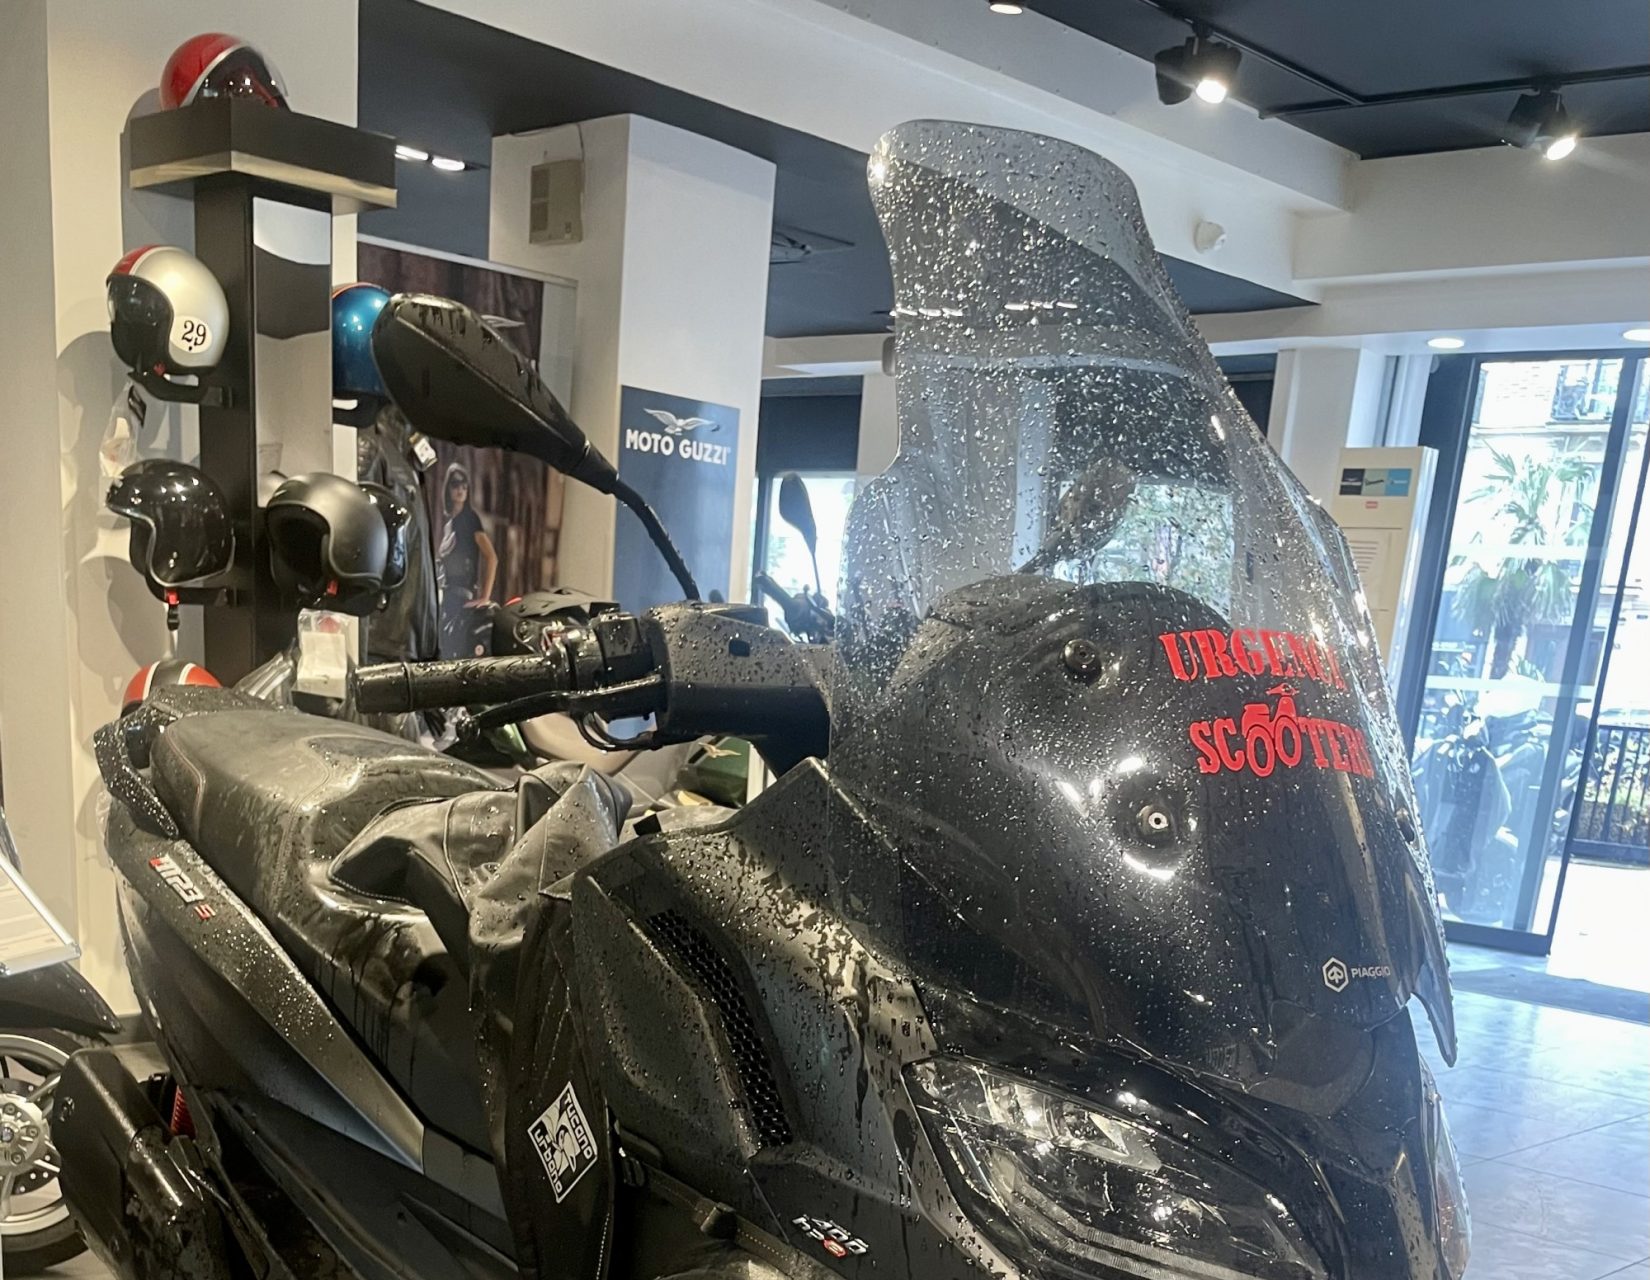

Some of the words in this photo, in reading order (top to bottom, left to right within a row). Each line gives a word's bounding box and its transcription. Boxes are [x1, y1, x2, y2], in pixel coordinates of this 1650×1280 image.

[182, 320, 207, 346] 29
[625, 428, 675, 456] MOTO
[679, 439, 727, 465] GUZZI
[149, 853, 205, 903] MP3
[1351, 966, 1391, 978] PIAGGIO
